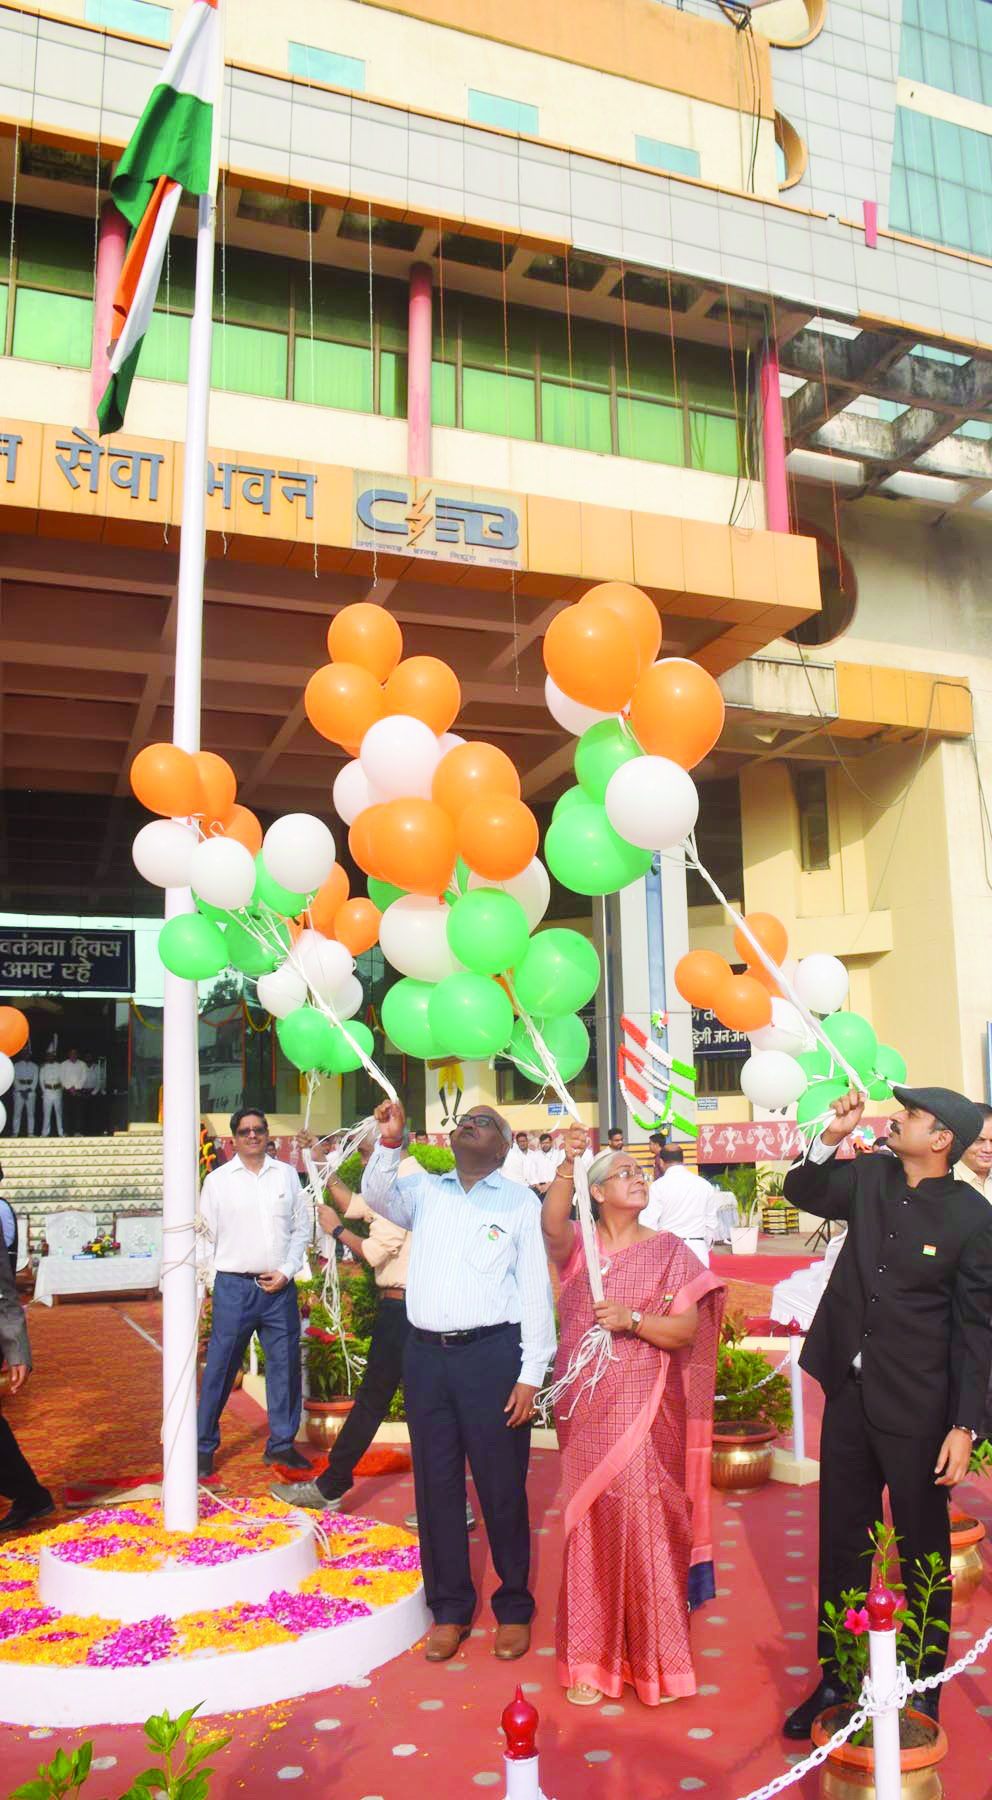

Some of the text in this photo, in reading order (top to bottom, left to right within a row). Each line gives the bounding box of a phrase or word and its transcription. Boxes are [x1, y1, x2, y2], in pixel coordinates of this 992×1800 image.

[56, 427, 164, 501] सेवा
[207, 460, 318, 520] भवन
[0, 933, 122, 959] वतंत्रता दिवस
[1, 957, 94, 983] अमर रहे
